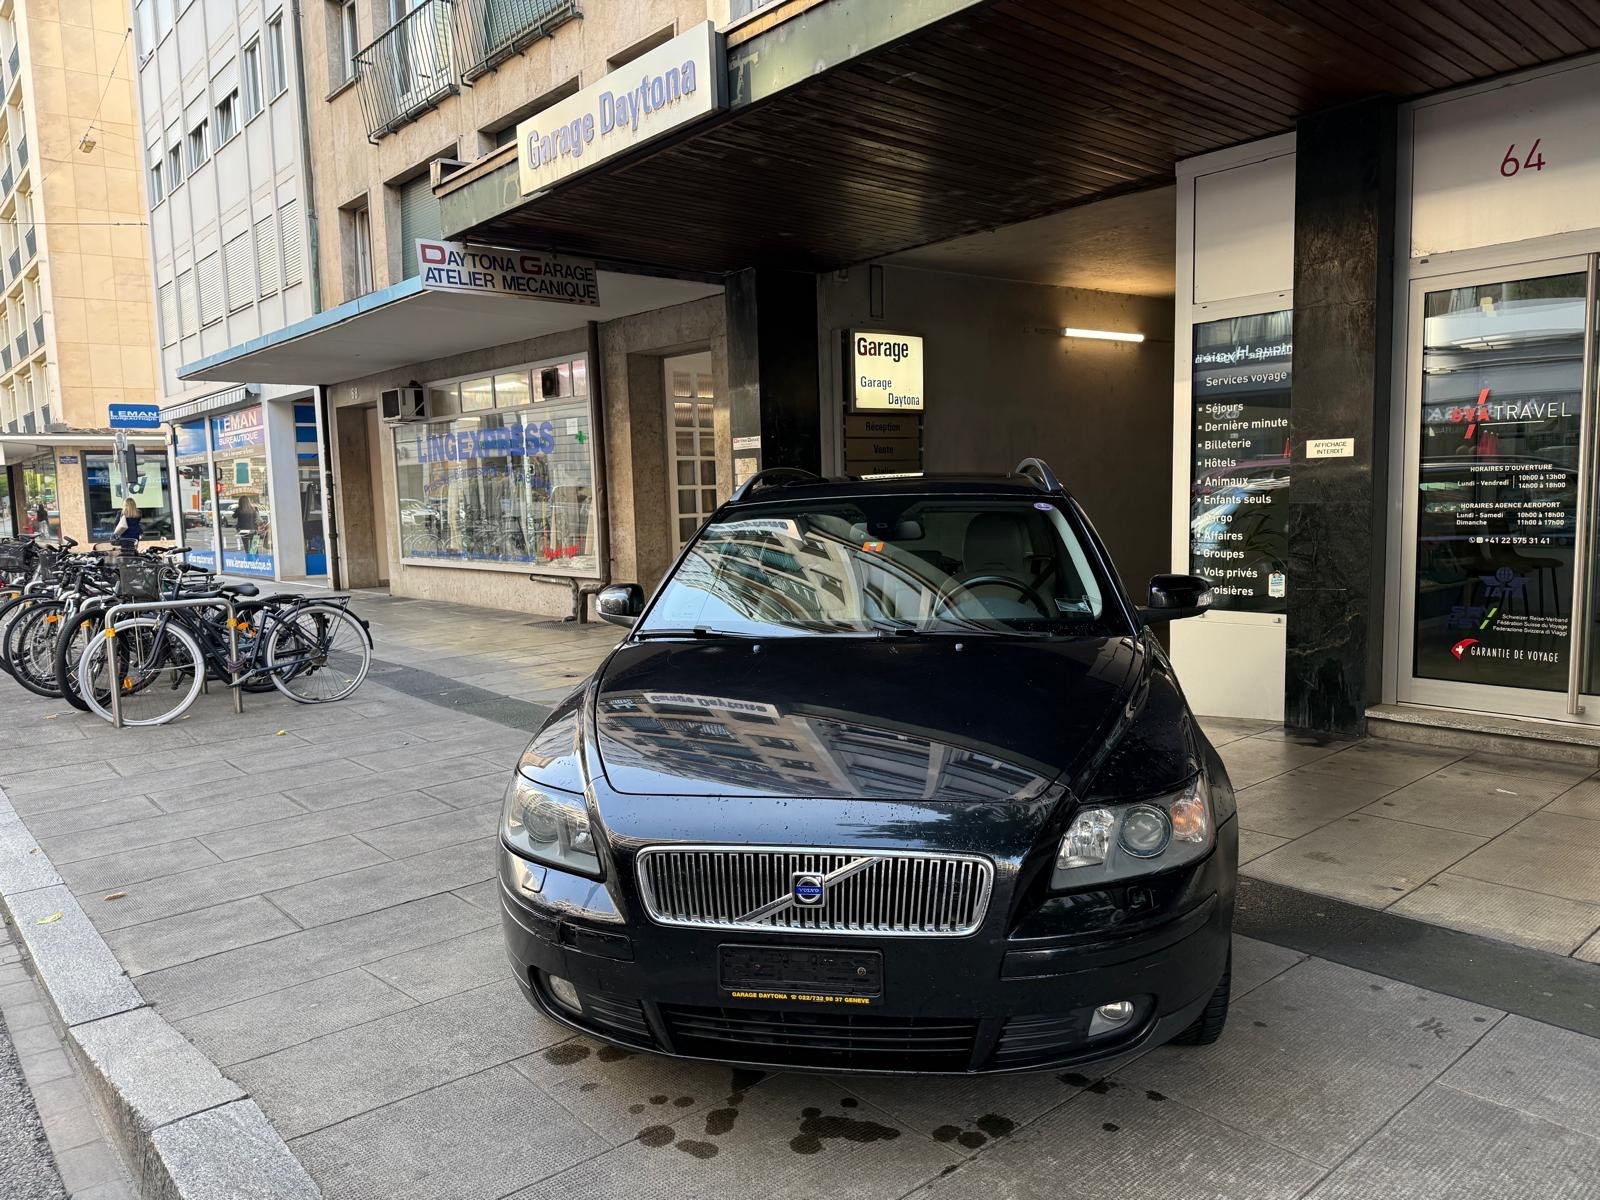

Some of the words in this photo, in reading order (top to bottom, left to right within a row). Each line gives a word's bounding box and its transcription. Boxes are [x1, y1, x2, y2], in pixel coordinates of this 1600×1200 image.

[526, 111, 594, 170] Garage
[599, 57, 697, 136] Daytona
[1500, 138, 1546, 177] 64
[420, 244, 516, 272] DAYTONA
[520, 256, 595, 282] GARAGE
[425, 269, 495, 288] ATELIER
[502, 275, 596, 299] MECANIQUE
[857, 338, 909, 362] Garage
[860, 376, 892, 390] Garage
[1206, 375, 1248, 386] Services
[1250, 372, 1287, 384] voyage
[888, 393, 920, 407] Daytona
[1206, 403, 1244, 414] Séjours
[1494, 402, 1572, 420] TRAVEL
[218, 411, 257, 437] LEMAN
[1204, 420, 1248, 432] Dernière
[1252, 418, 1288, 428] minute
[219, 432, 258, 447] BUREAUTIQUE
[416, 421, 555, 464] LINGEXPRESS
[1204, 438, 1252, 450] Billeterie
[1204, 458, 1236, 468] Hôtels
[1204, 476, 1248, 486] Animaux
[1204, 496, 1242, 504] Enfants
[1244, 494, 1272, 504] seuls
[1204, 531, 1243, 540] Affaires
[1204, 548, 1244, 560] Groupes
[1204, 568, 1224, 577] Vols
[1226, 568, 1258, 578] privés
[1471, 646, 1510, 659] GARANTIE
[1514, 650, 1524, 659] DE
[1528, 650, 1559, 662] VOYAGE
